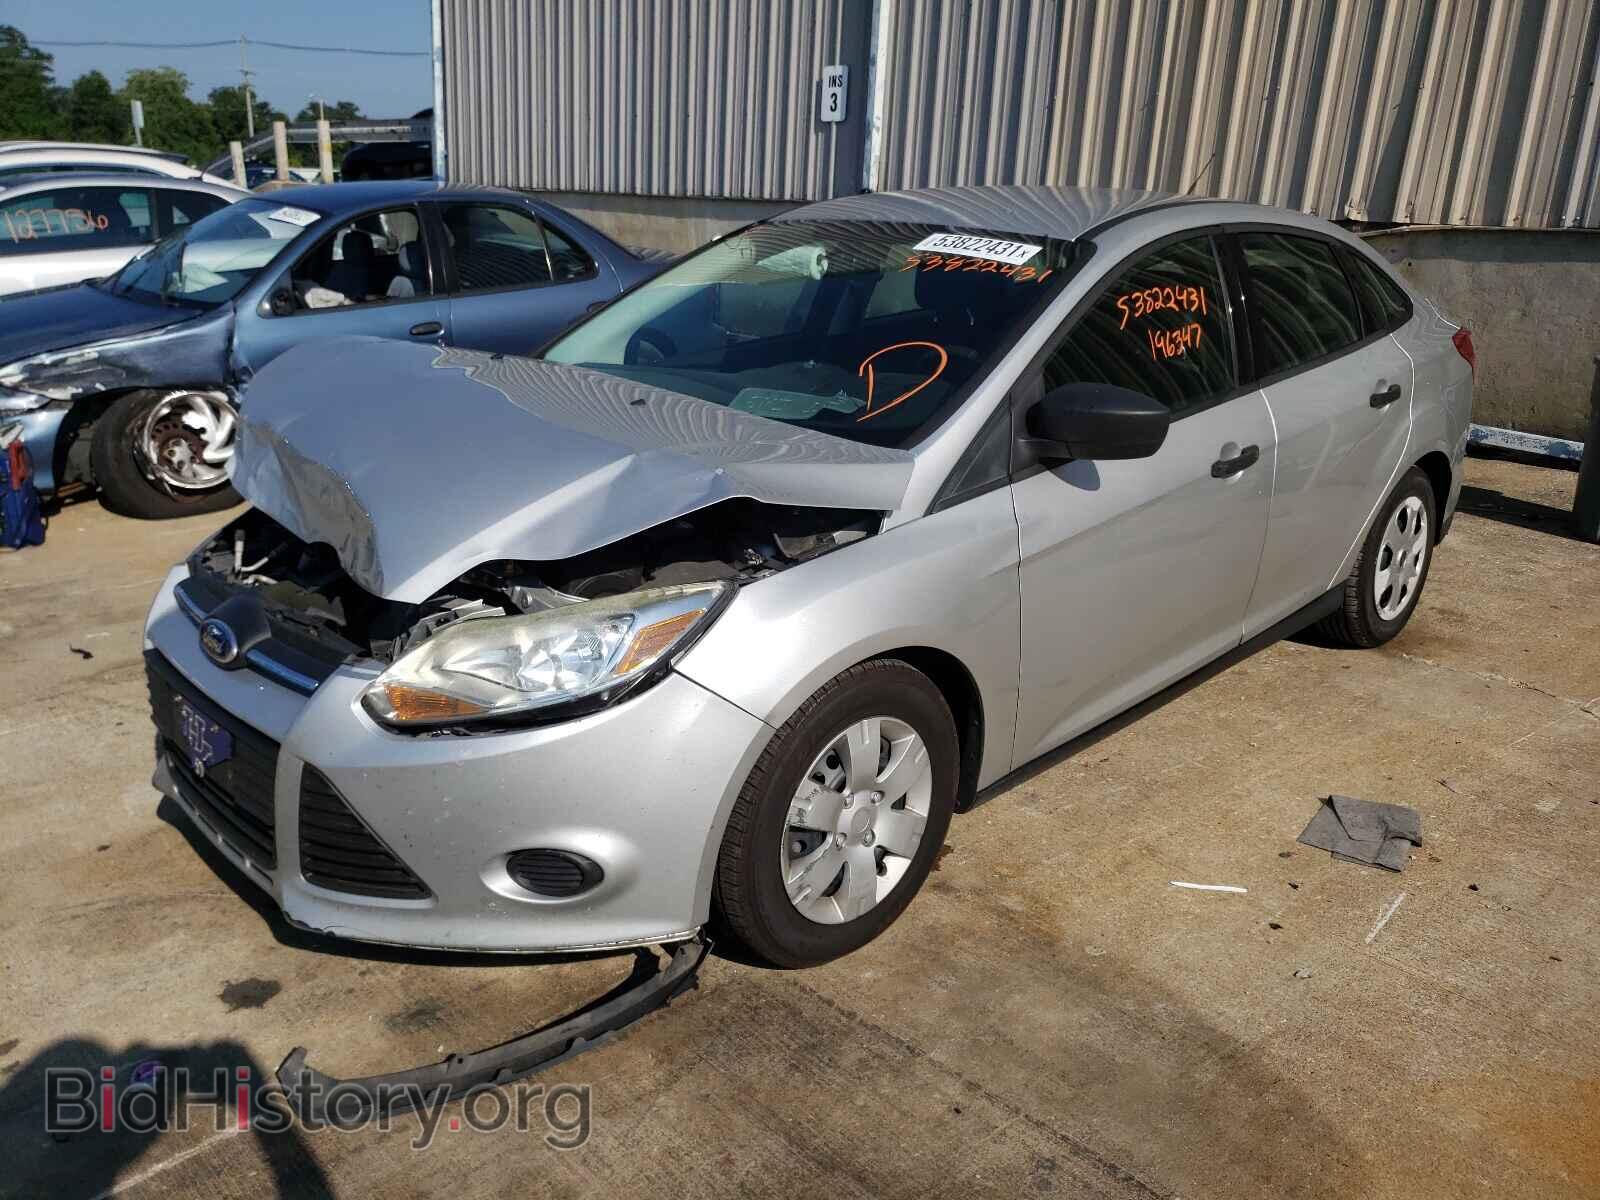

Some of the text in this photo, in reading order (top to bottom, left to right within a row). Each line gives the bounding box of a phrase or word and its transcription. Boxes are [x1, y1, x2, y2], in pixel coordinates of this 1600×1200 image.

[829, 75, 843, 88] INS
[830, 92, 837, 112] 3
[900, 254, 1053, 284] 53822431
[1117, 285, 1206, 330] 53822431
[1147, 323, 1201, 361] 196347
[856, 341, 948, 422] D
